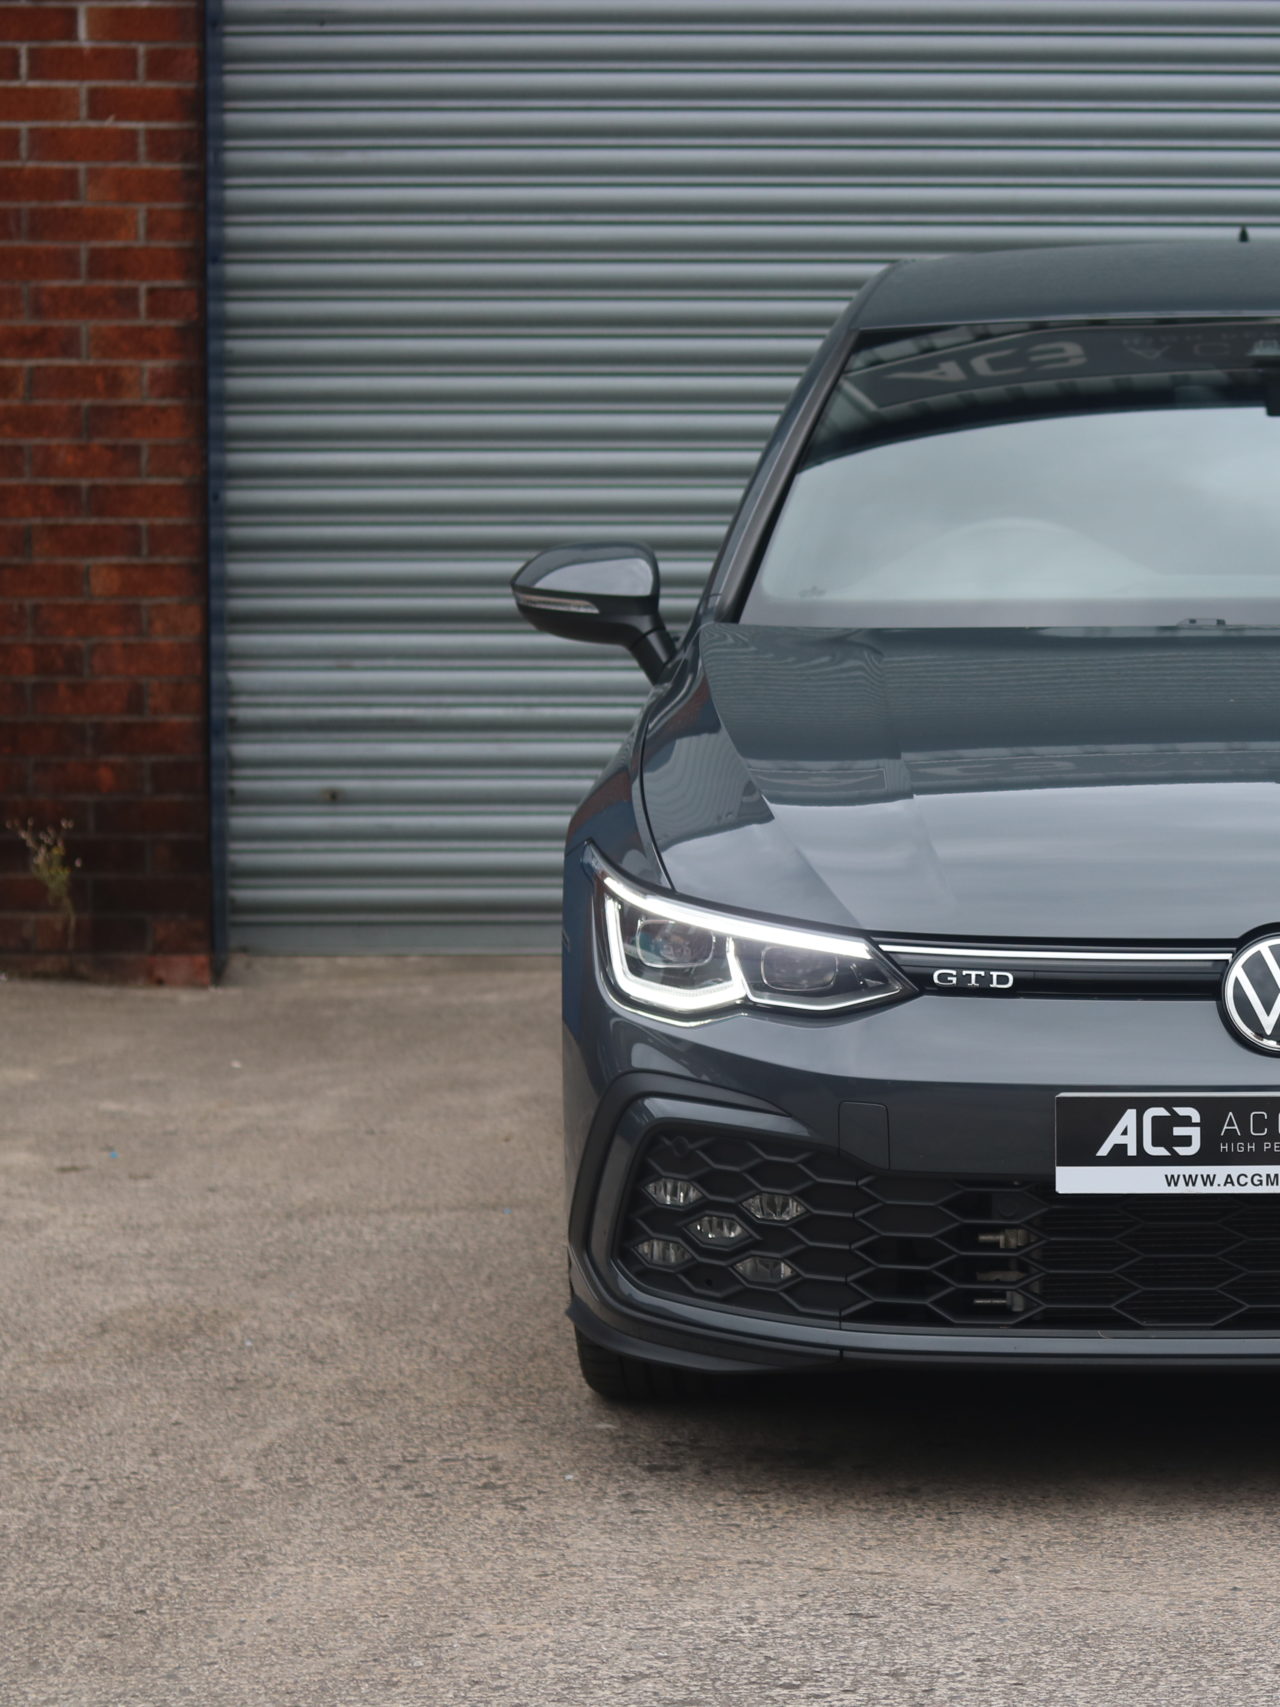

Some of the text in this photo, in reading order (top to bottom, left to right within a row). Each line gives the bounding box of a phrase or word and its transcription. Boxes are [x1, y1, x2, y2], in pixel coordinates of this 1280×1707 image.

[932, 968, 1014, 989] GTD
[1095, 1106, 1201, 1157] ACG
[1219, 1141, 1257, 1153] HIGH
